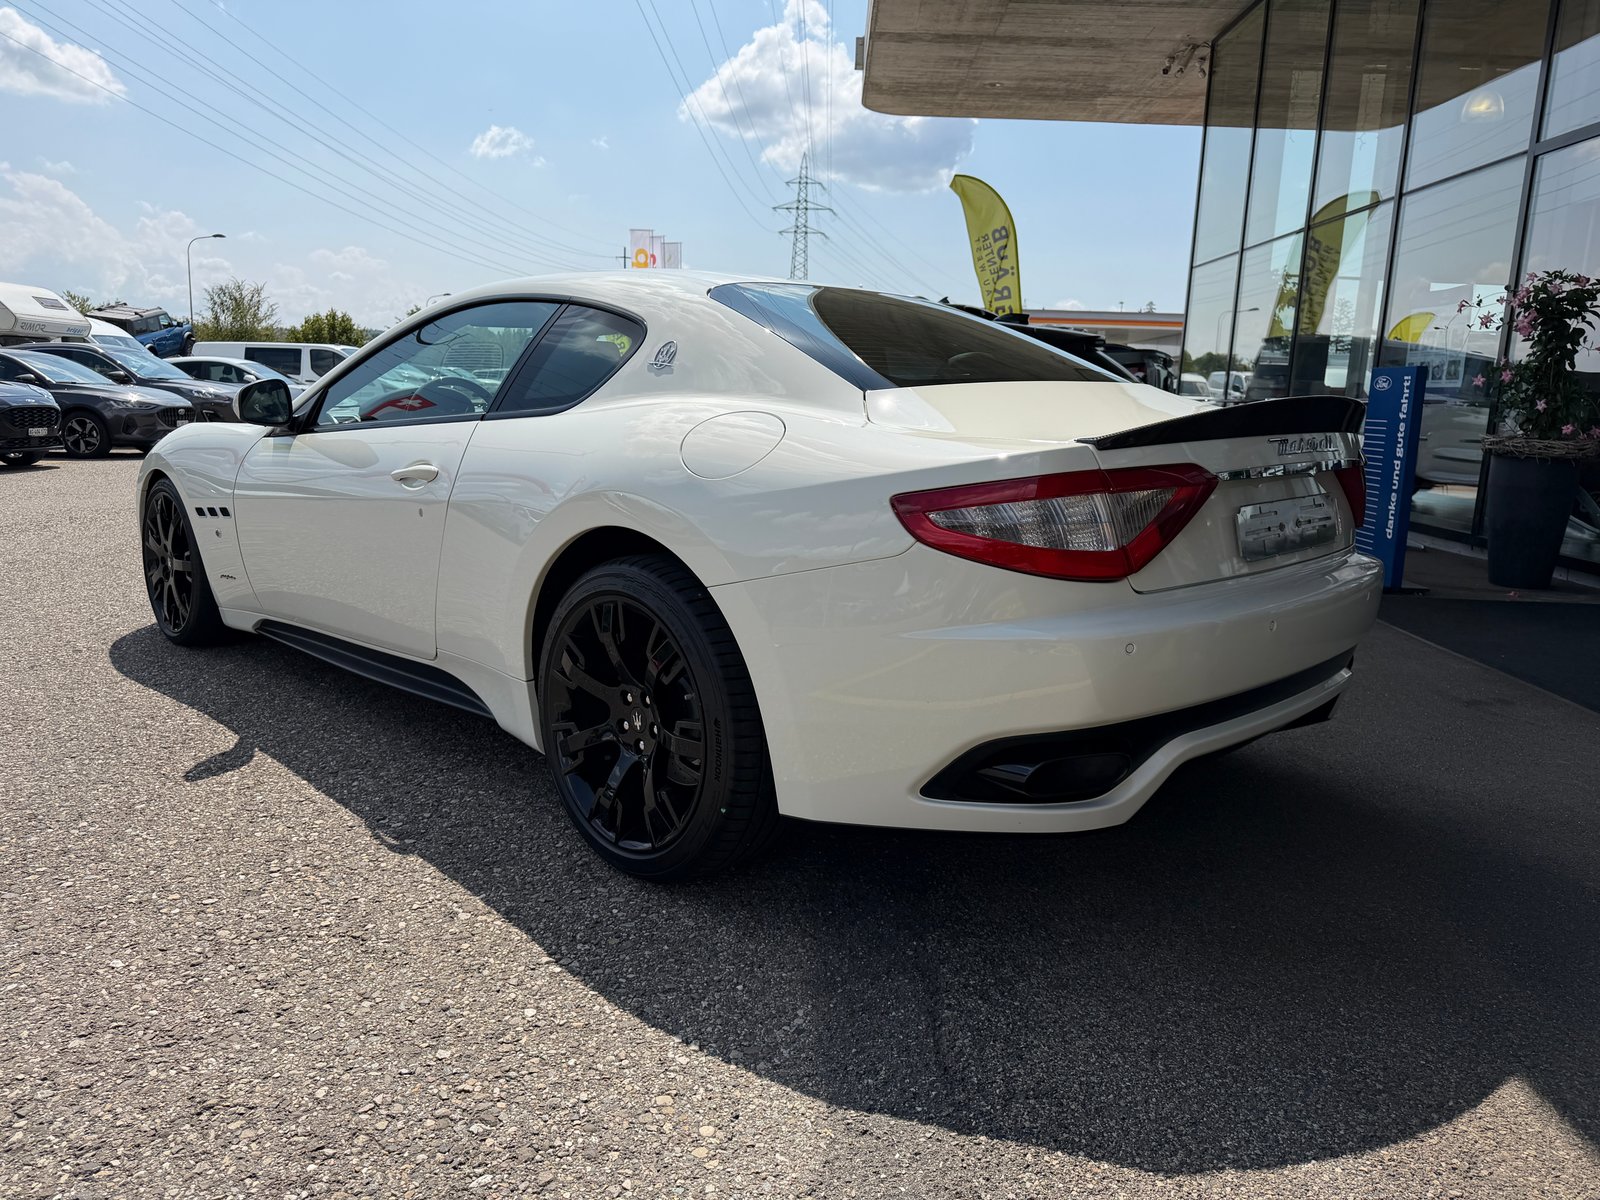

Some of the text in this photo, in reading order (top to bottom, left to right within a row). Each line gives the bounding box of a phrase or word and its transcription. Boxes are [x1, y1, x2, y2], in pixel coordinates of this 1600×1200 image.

[1386, 375, 1411, 540] danke und gute fahrt!
